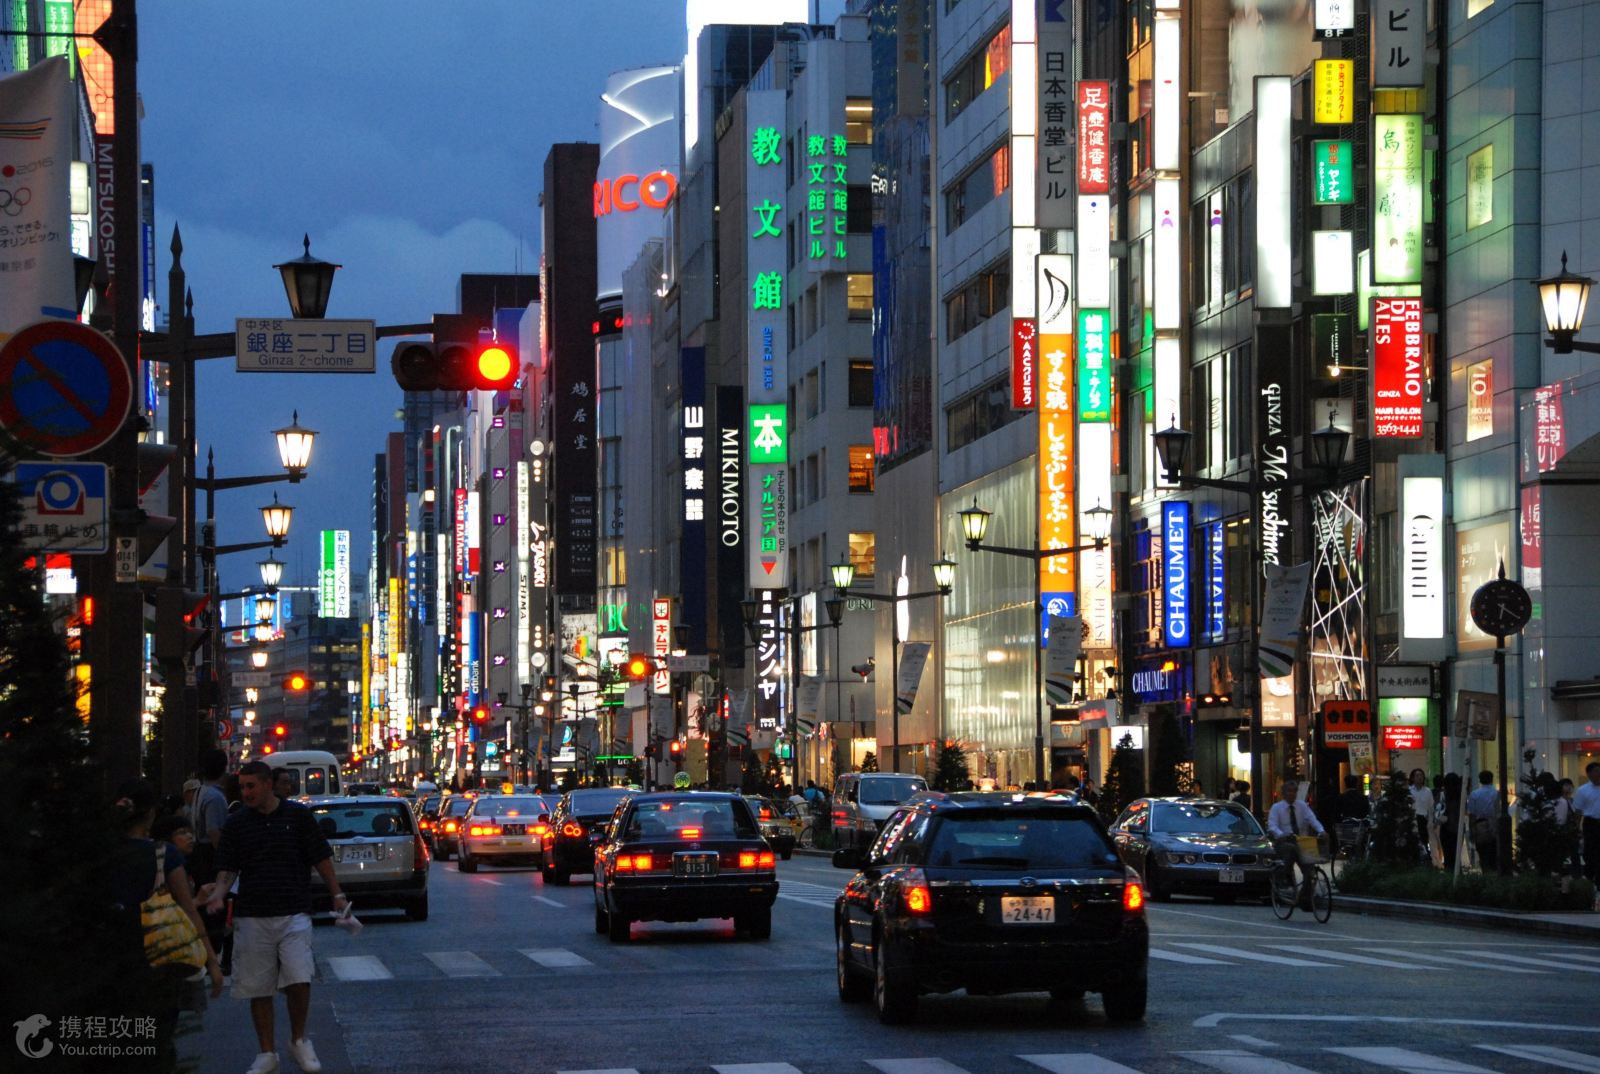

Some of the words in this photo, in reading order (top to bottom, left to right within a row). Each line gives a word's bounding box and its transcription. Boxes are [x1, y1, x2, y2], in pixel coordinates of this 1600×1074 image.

[1044, 51, 1067, 200] 日本香堂ビル
[98, 143, 116, 275] MITSUKOSHI
[752, 127, 782, 310] 教文館
[807, 134, 826, 259] 教文館ビル
[832, 134, 848, 259] 教文館ビル
[245, 319, 283, 331] 中央区
[1375, 300, 1391, 345] ALES
[1390, 300, 1405, 322] DI
[246, 332, 366, 354] 銀座二丁目
[258, 354, 294, 366] Ginza
[299, 354, 354, 366] 2-chome
[1405, 300, 1421, 396] FEBBRAIO
[1261, 383, 1281, 436] GINZA
[1377, 390, 1401, 398] GINZA
[1394, 407, 1422, 415] SALON
[753, 413, 782, 454] 本
[1376, 422, 1420, 436] 3563-1441
[722, 428, 740, 547] MIKIMOTO
[761, 474, 777, 552] ナルニア国
[519, 573, 528, 620] SHIMA
[1169, 511, 1187, 639] CHAUMET
[471, 660, 479, 694] citibank
[655, 624, 668, 690] キムラパン
[1132, 669, 1171, 694] CHAUMET
[1014, 908, 1051, 921] 24-47
